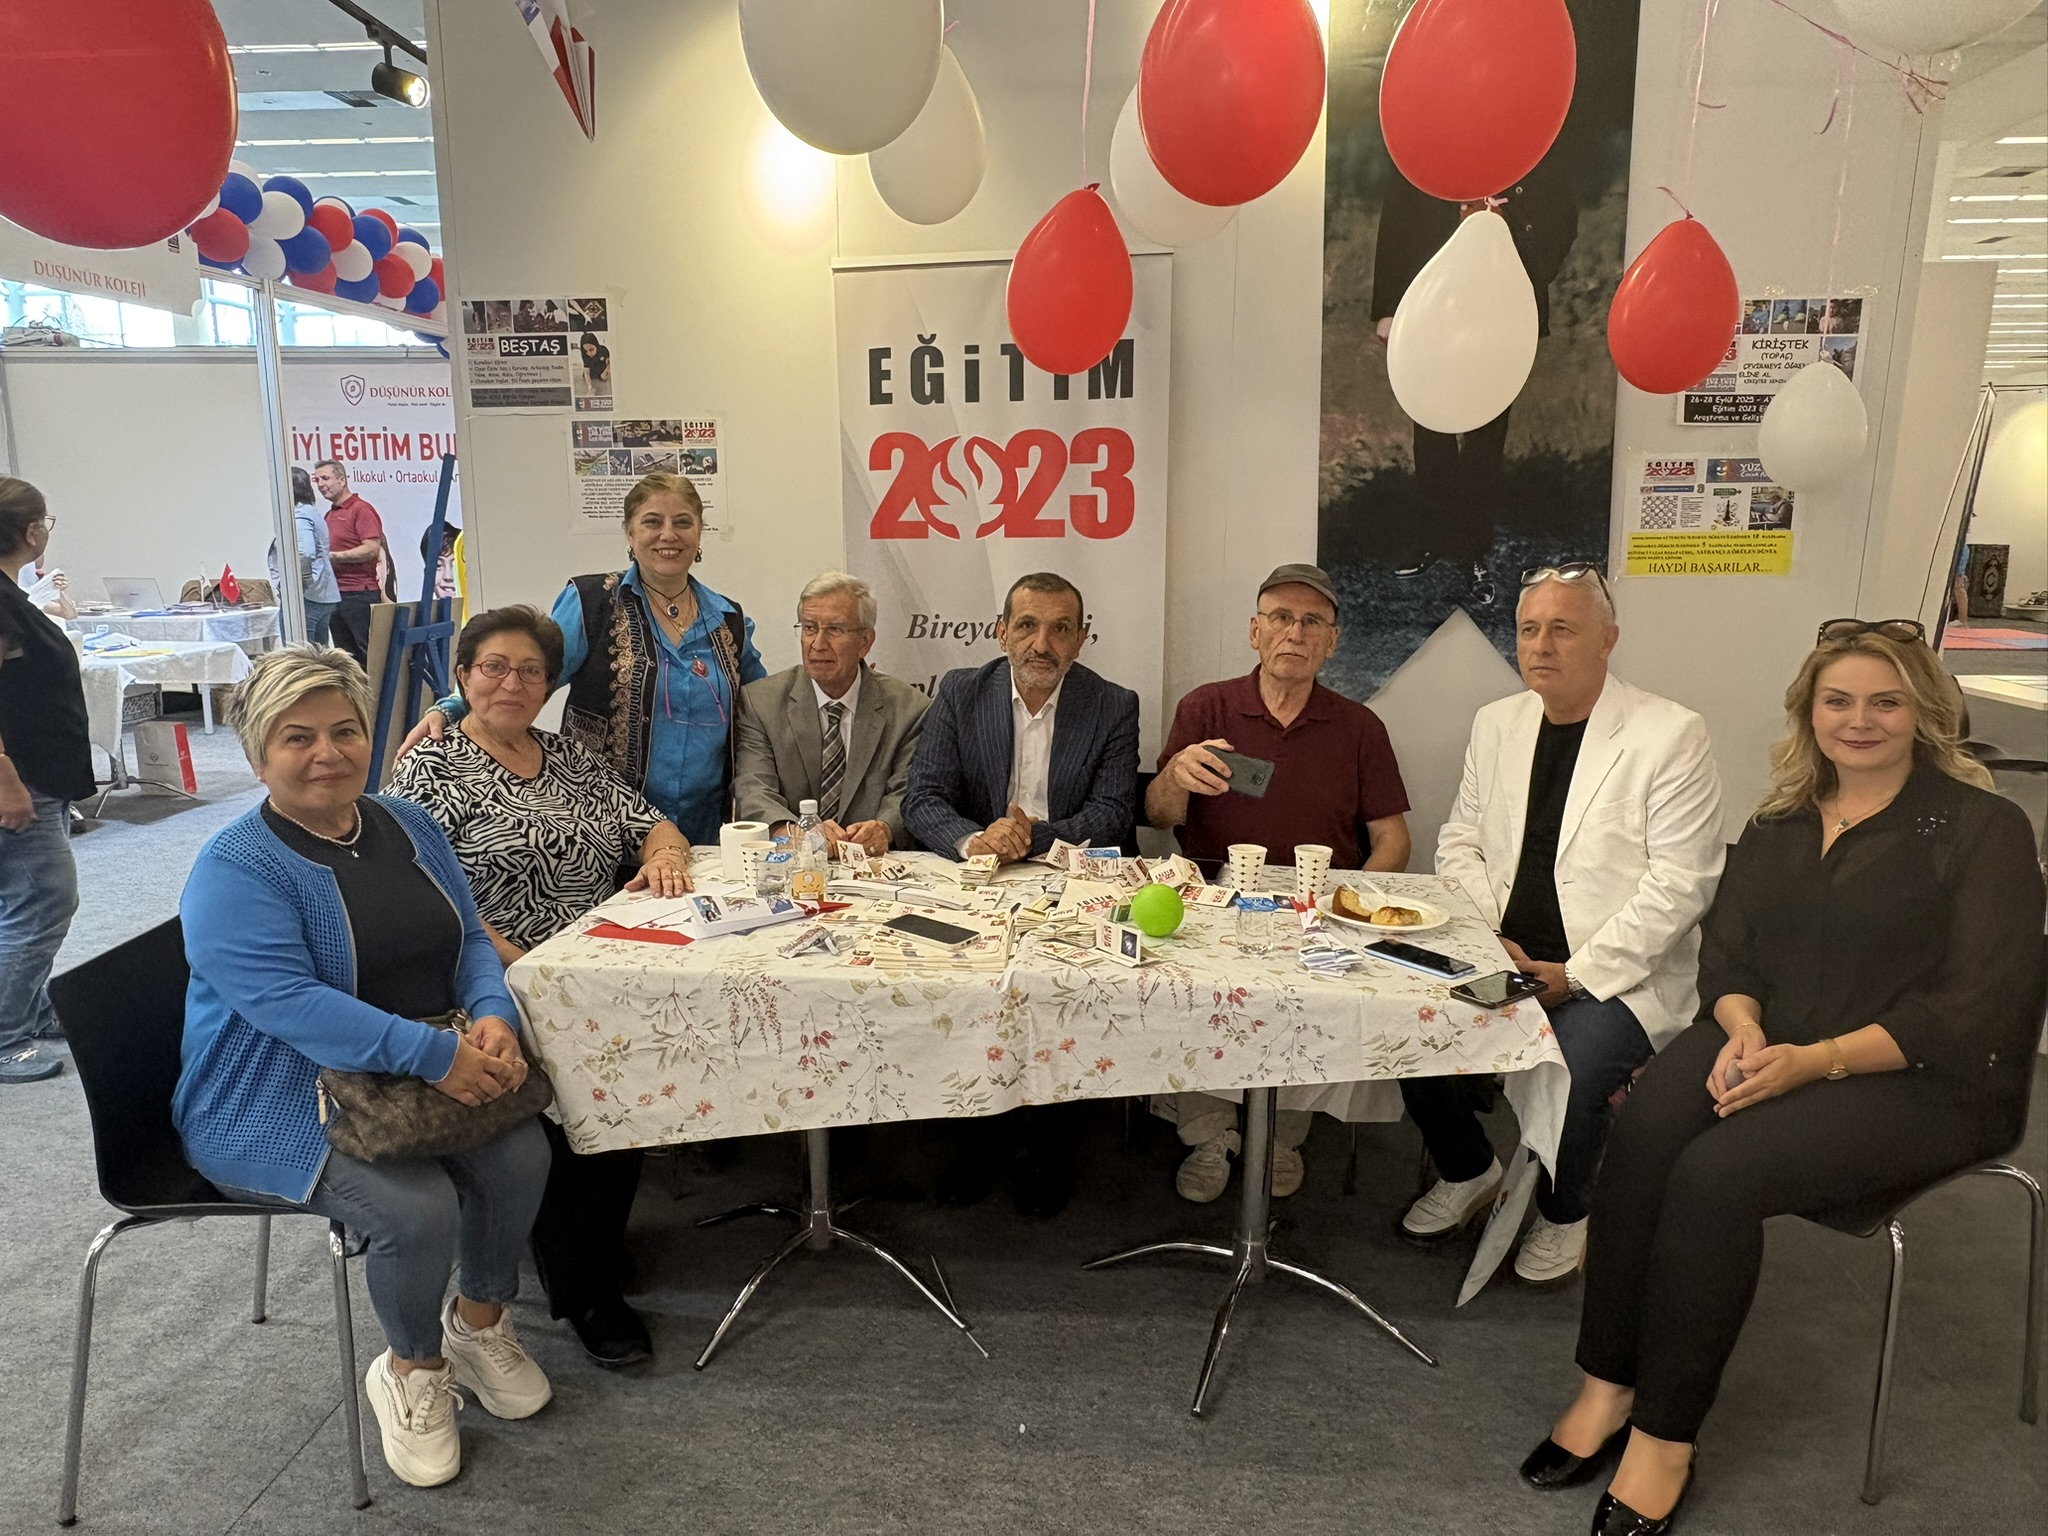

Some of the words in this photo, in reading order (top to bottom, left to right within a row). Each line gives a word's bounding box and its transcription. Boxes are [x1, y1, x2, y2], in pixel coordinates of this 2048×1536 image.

[500, 339, 560, 356] BEŞTAŞ
[1751, 338, 1809, 352] KİRİŞTEK
[370, 385, 427, 400] DÜŞÜNÜR
[292, 426, 322, 461] İYİ
[330, 426, 411, 461] EĞİTİM
[352, 467, 387, 483] İlkokul
[395, 470, 438, 483] Ortaokul
[869, 427, 1135, 540] 2023
[1649, 562, 1687, 573] HAYDİ
